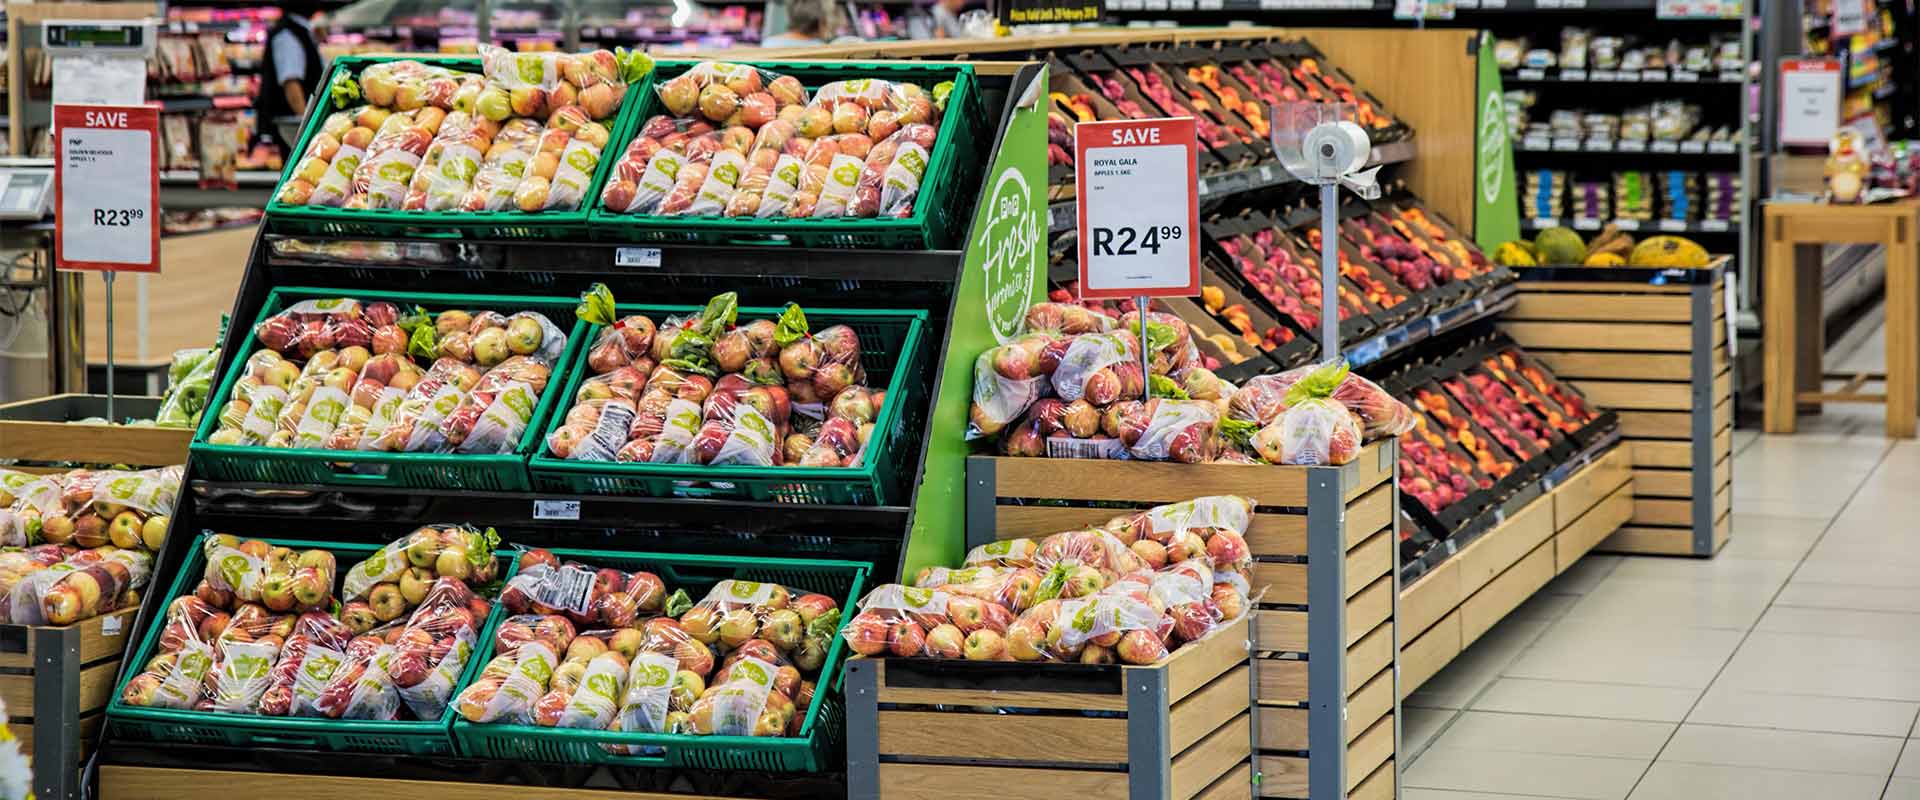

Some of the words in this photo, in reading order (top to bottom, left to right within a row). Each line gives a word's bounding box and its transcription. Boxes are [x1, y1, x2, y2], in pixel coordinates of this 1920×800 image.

[85, 111, 128, 128] SAVE
[1112, 127, 1160, 145] SAVE
[1094, 159, 1117, 167] ROYAL
[1119, 158, 1137, 166] GALA
[979, 186, 1041, 284] Fresh
